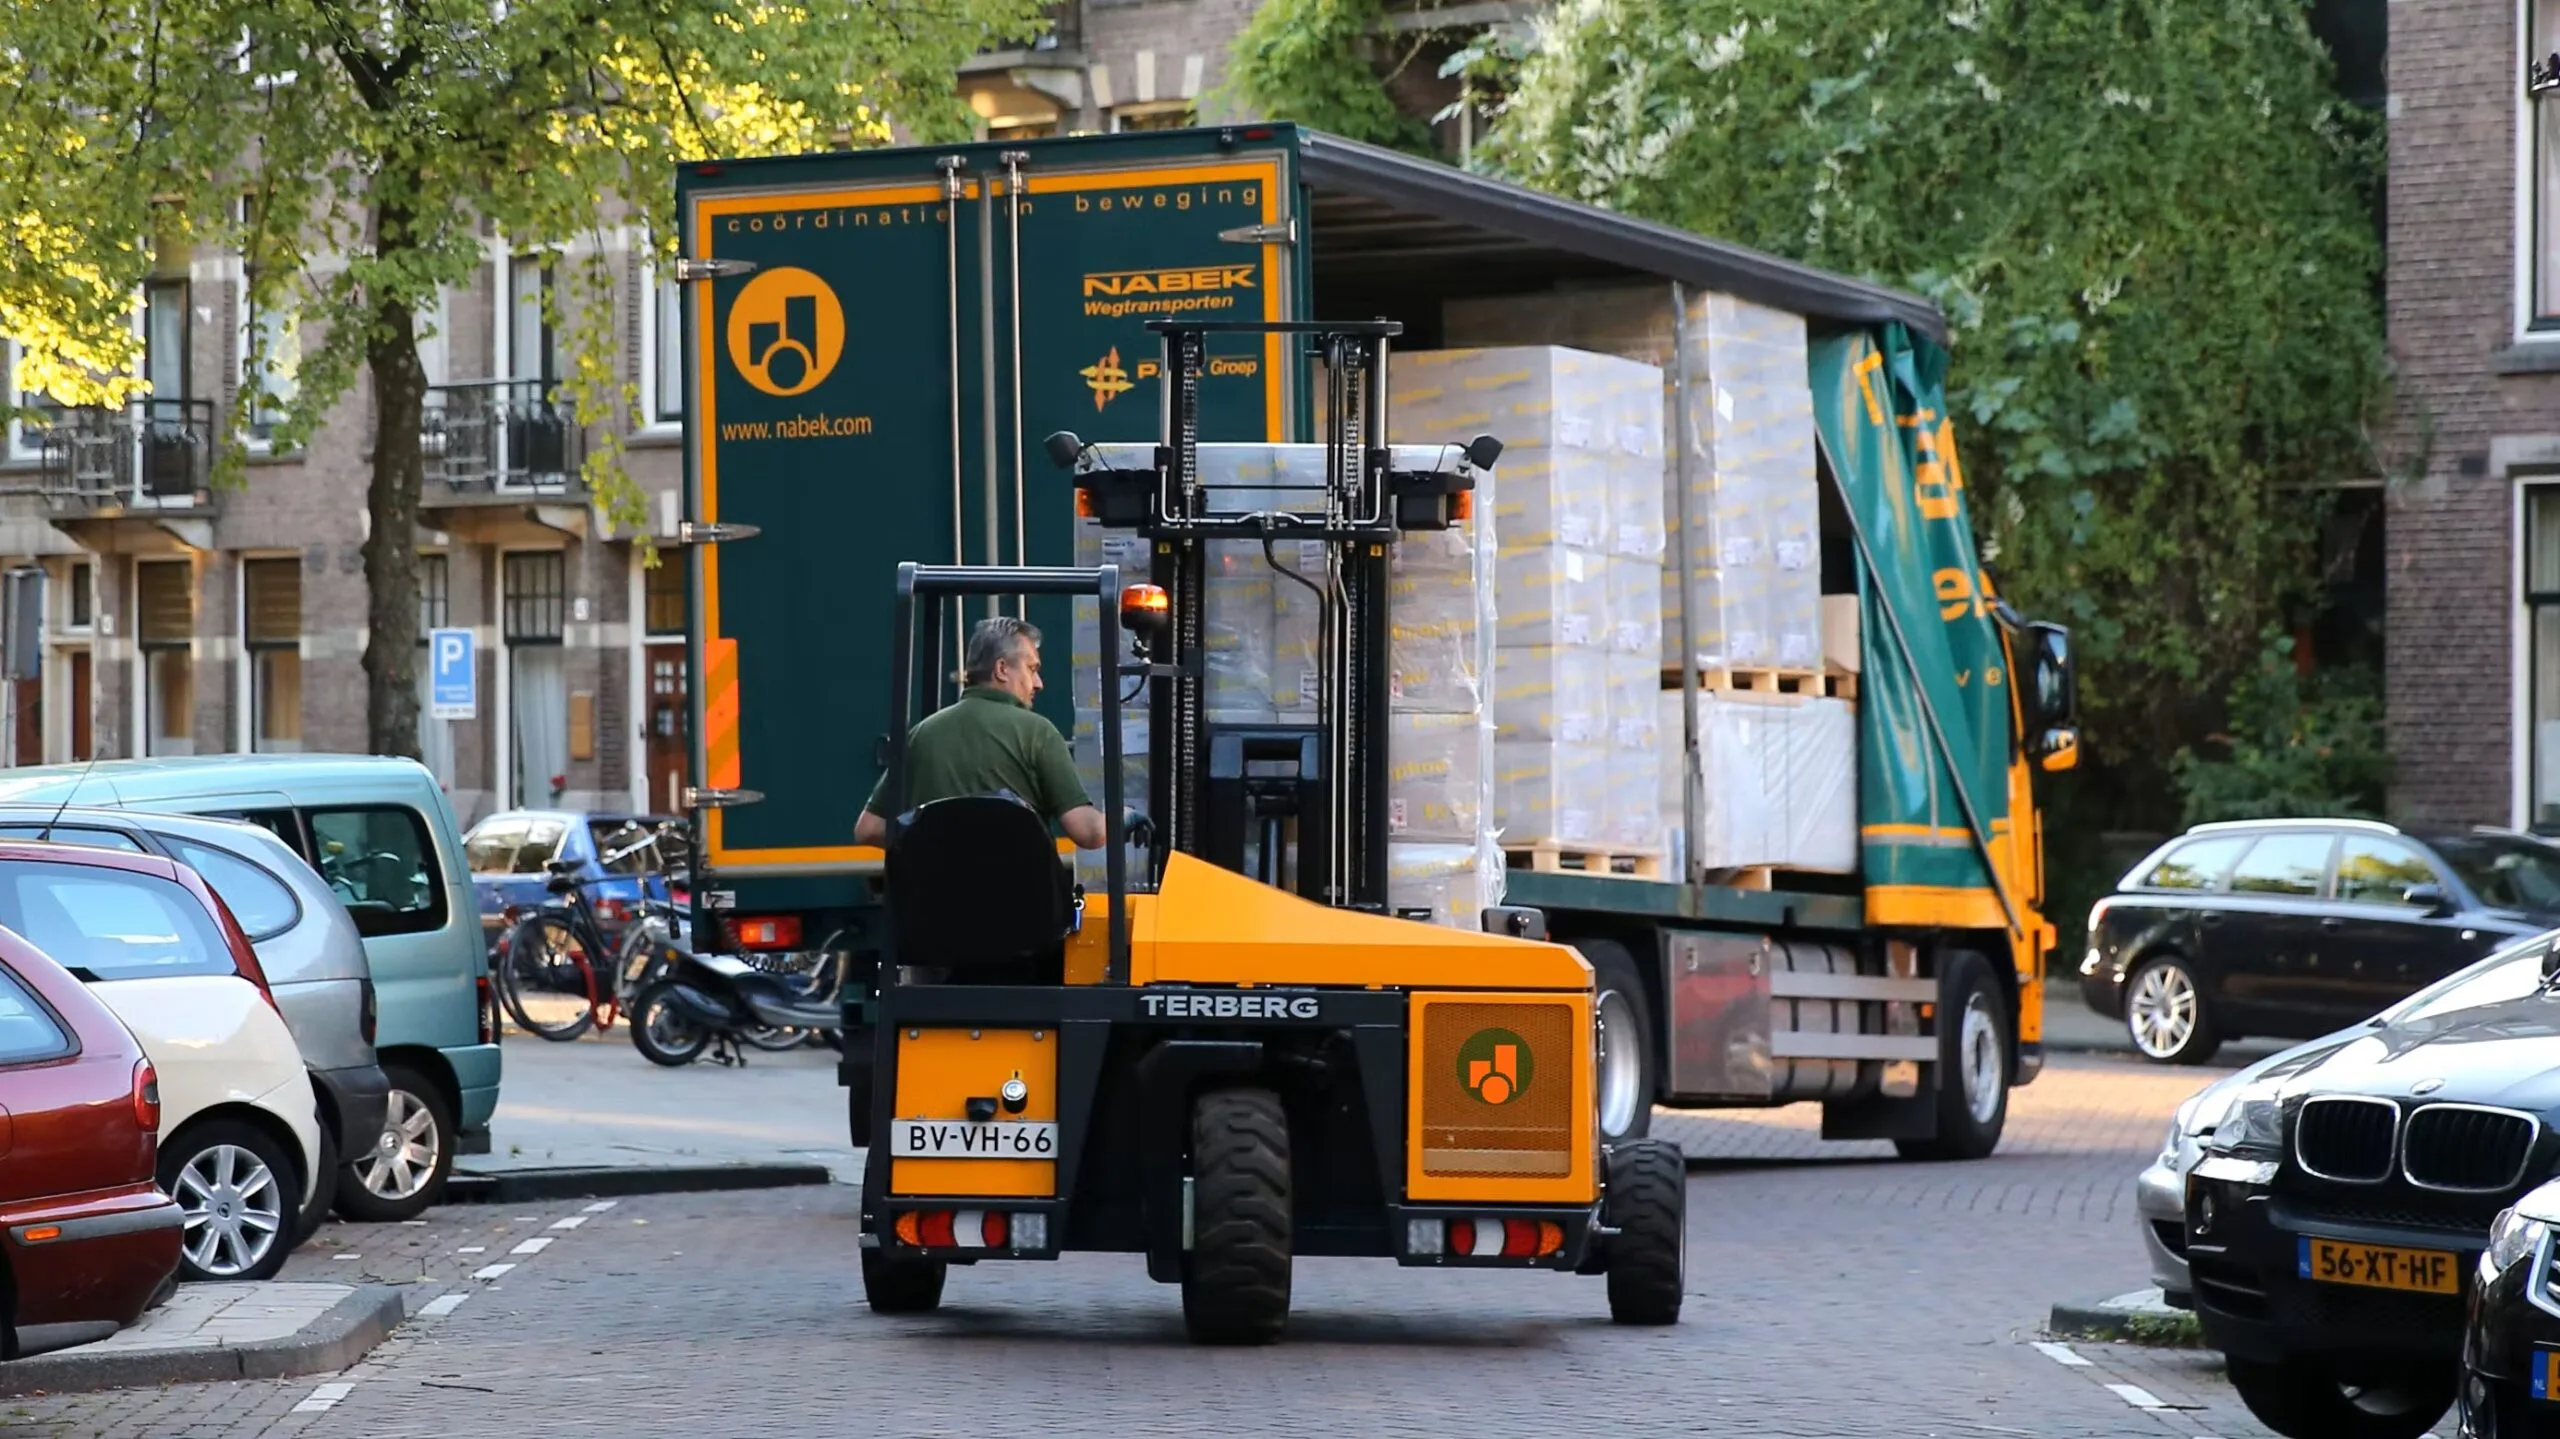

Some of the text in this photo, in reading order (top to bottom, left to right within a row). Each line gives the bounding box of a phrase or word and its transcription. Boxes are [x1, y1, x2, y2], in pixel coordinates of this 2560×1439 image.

[1075, 186, 1257, 213] beweging
[1083, 268, 1256, 297] NABEK
[1084, 295, 1233, 318] Wegtransporten
[1210, 359, 1257, 378] Groep
[441, 637, 464, 675] P
[1139, 995, 1319, 1019] TERBERG
[910, 1126, 1052, 1153] BV-VH-66
[2320, 1245, 2447, 1286] 56-XT-HF
